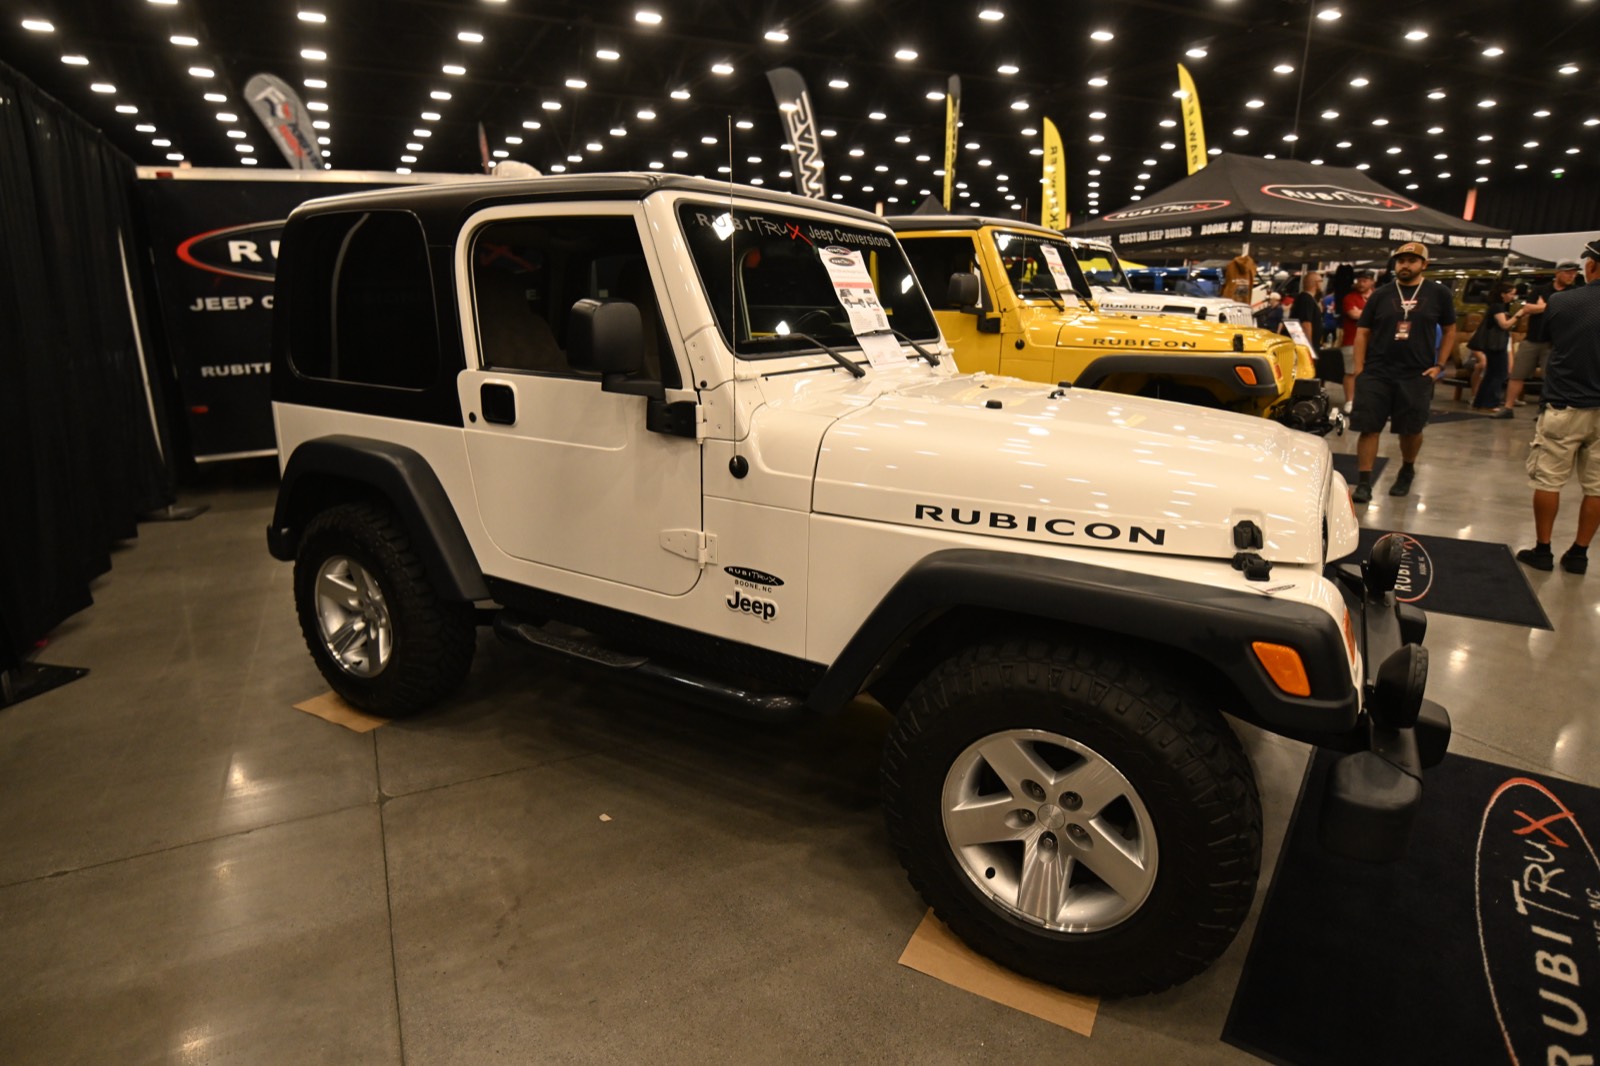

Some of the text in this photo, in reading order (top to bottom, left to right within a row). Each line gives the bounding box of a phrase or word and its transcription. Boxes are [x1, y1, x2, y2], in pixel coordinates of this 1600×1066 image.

[809, 225, 891, 248] Jeep Conversions
[1119, 232, 1148, 245] CUSTOM
[1149, 230, 1164, 241] JEEP
[190, 296, 253, 311] JEEP
[1093, 338, 1197, 348] RUBICON
[914, 504, 1166, 546] RUBICON
[726, 590, 776, 620] Jeep
